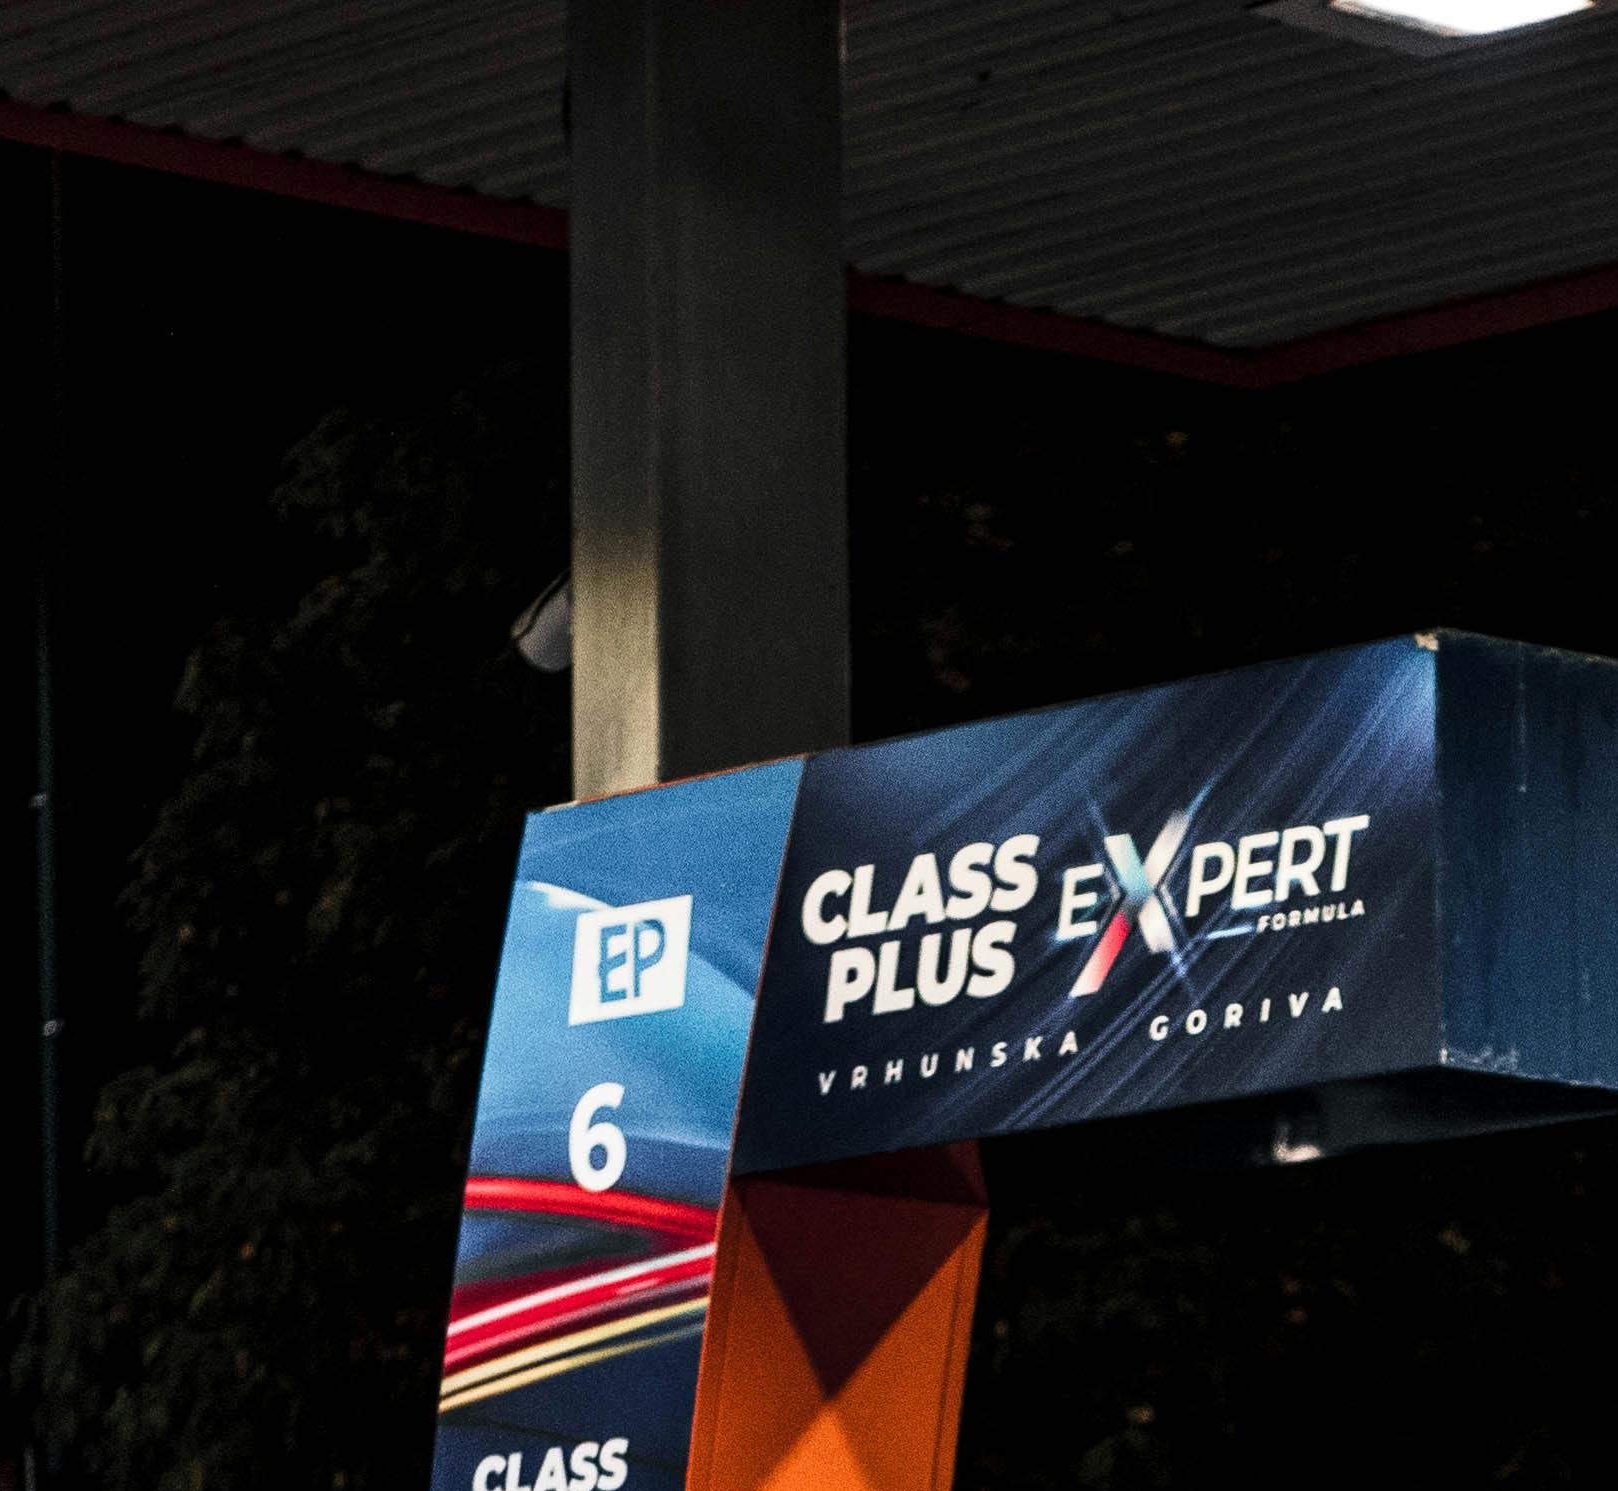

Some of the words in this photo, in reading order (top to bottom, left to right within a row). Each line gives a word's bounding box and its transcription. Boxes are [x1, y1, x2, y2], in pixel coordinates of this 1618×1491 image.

[801, 833, 1040, 944] CLASS
[1056, 810, 1370, 997] EXPERT
[1256, 899, 1366, 933] FORMULA
[599, 918, 666, 1003] EP
[824, 920, 1017, 1023] PLUS
[818, 1031, 1079, 1095] VRHUNSKA
[1148, 986, 1344, 1042] GORIVA
[569, 1082, 627, 1192] 6
